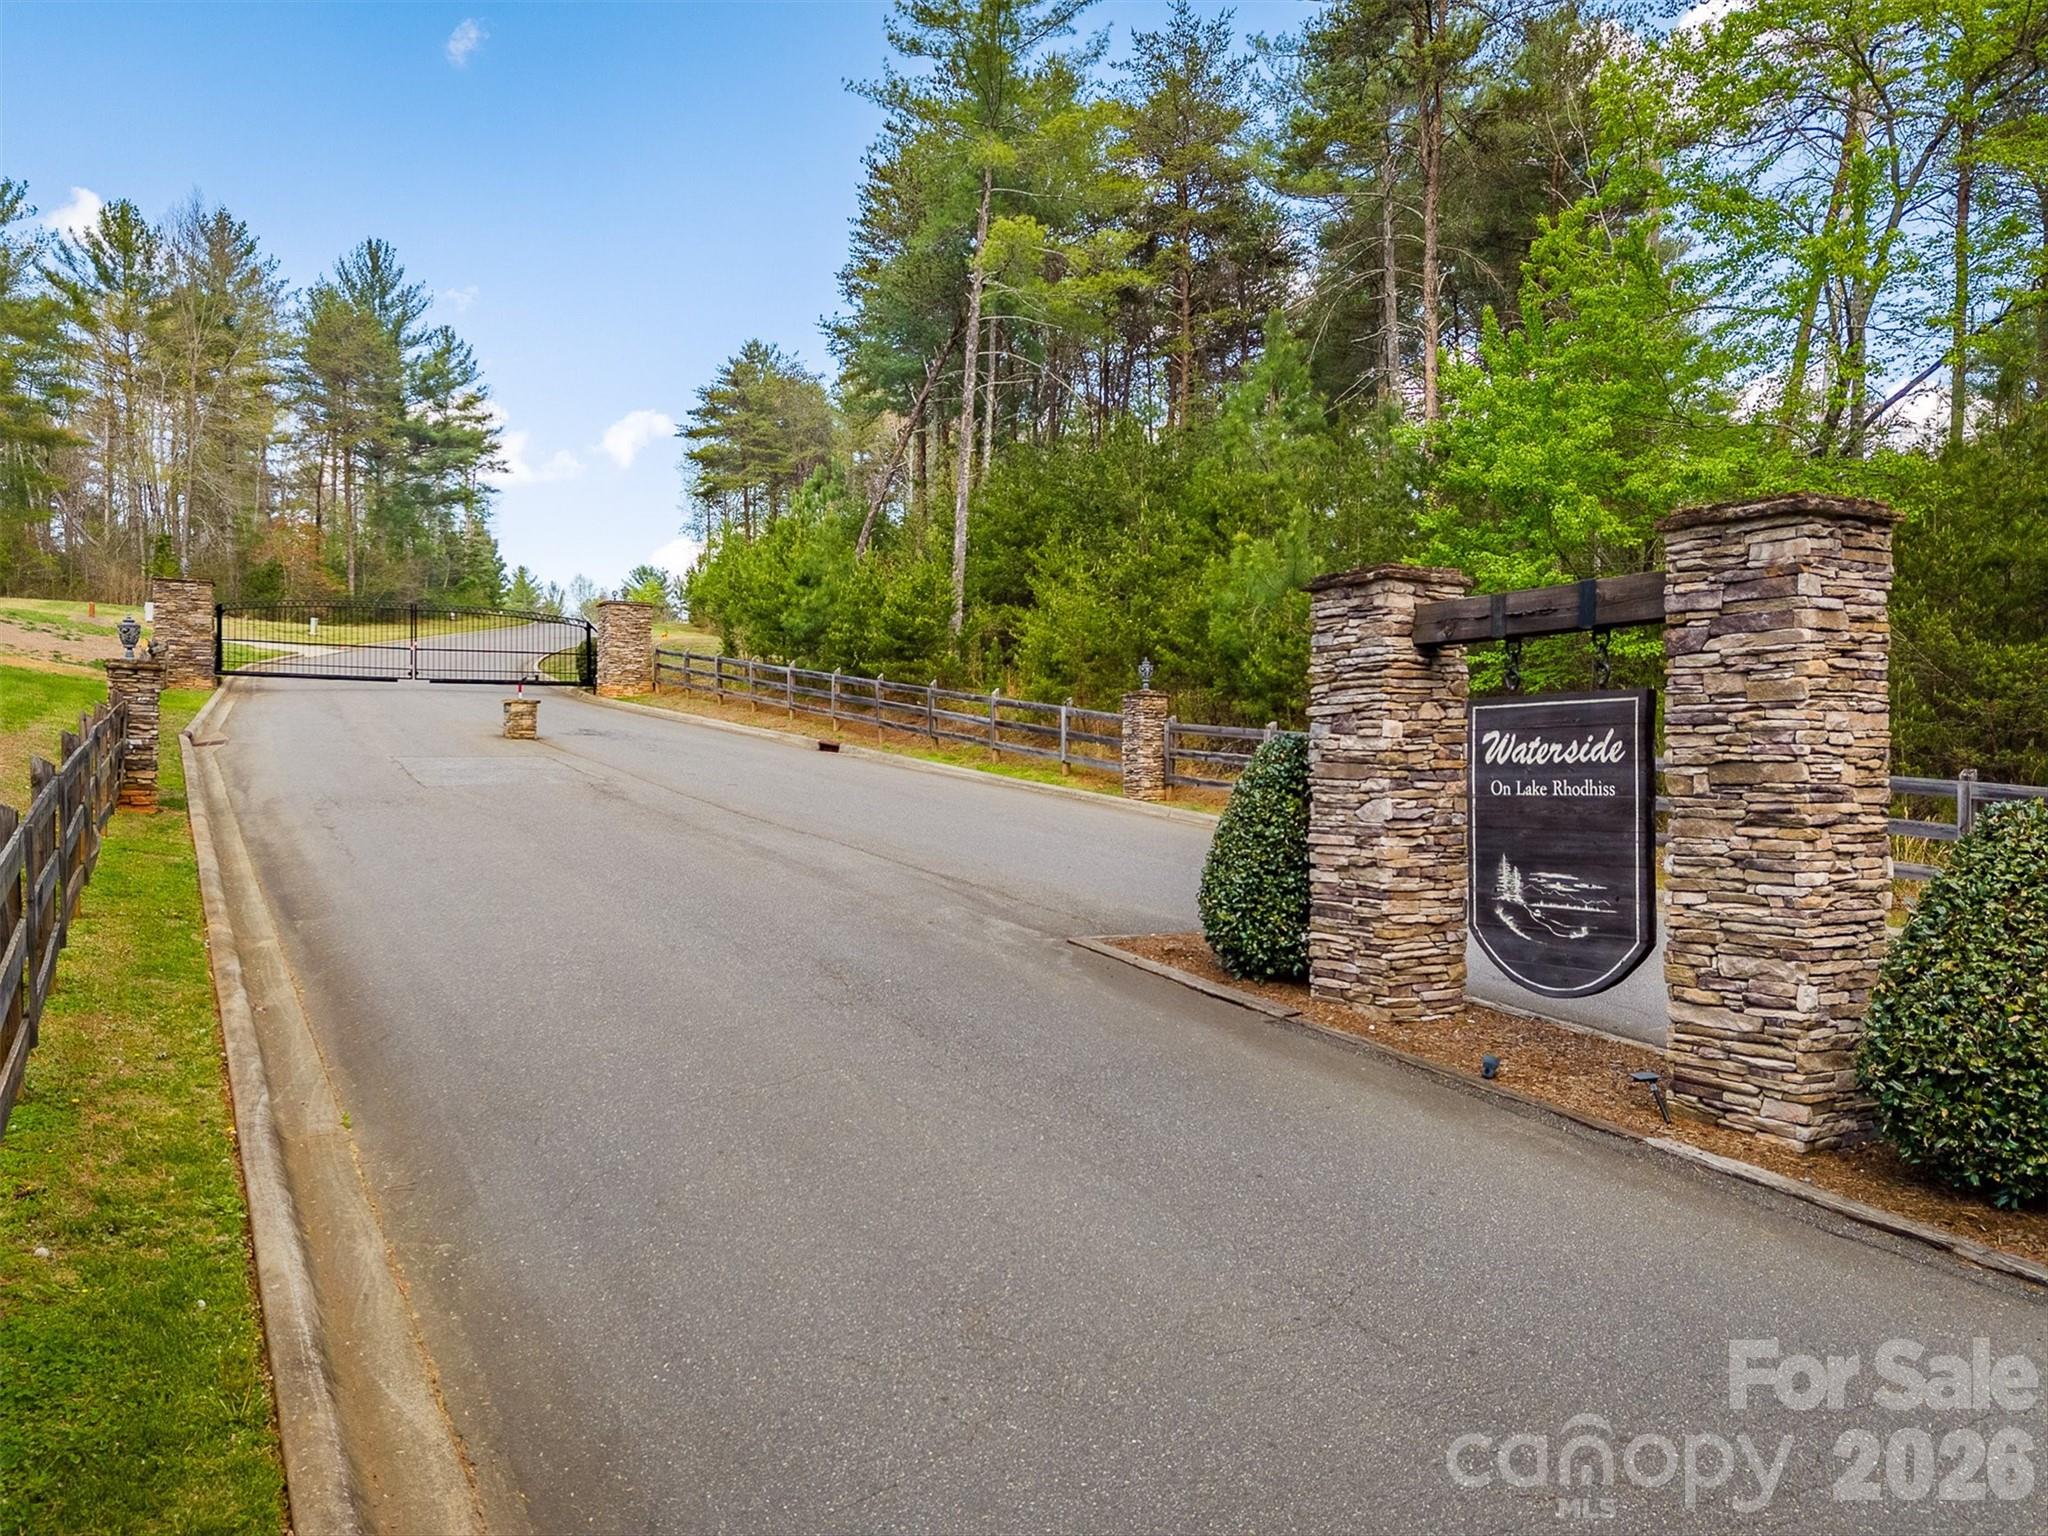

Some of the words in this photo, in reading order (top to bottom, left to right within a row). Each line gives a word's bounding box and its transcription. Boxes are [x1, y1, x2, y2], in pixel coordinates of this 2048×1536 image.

[1481, 728, 1626, 765] Waterside
[1490, 780, 1511, 796] On
[1515, 780, 1548, 797] Lake
[1552, 779, 1616, 797] Rhodhiss
